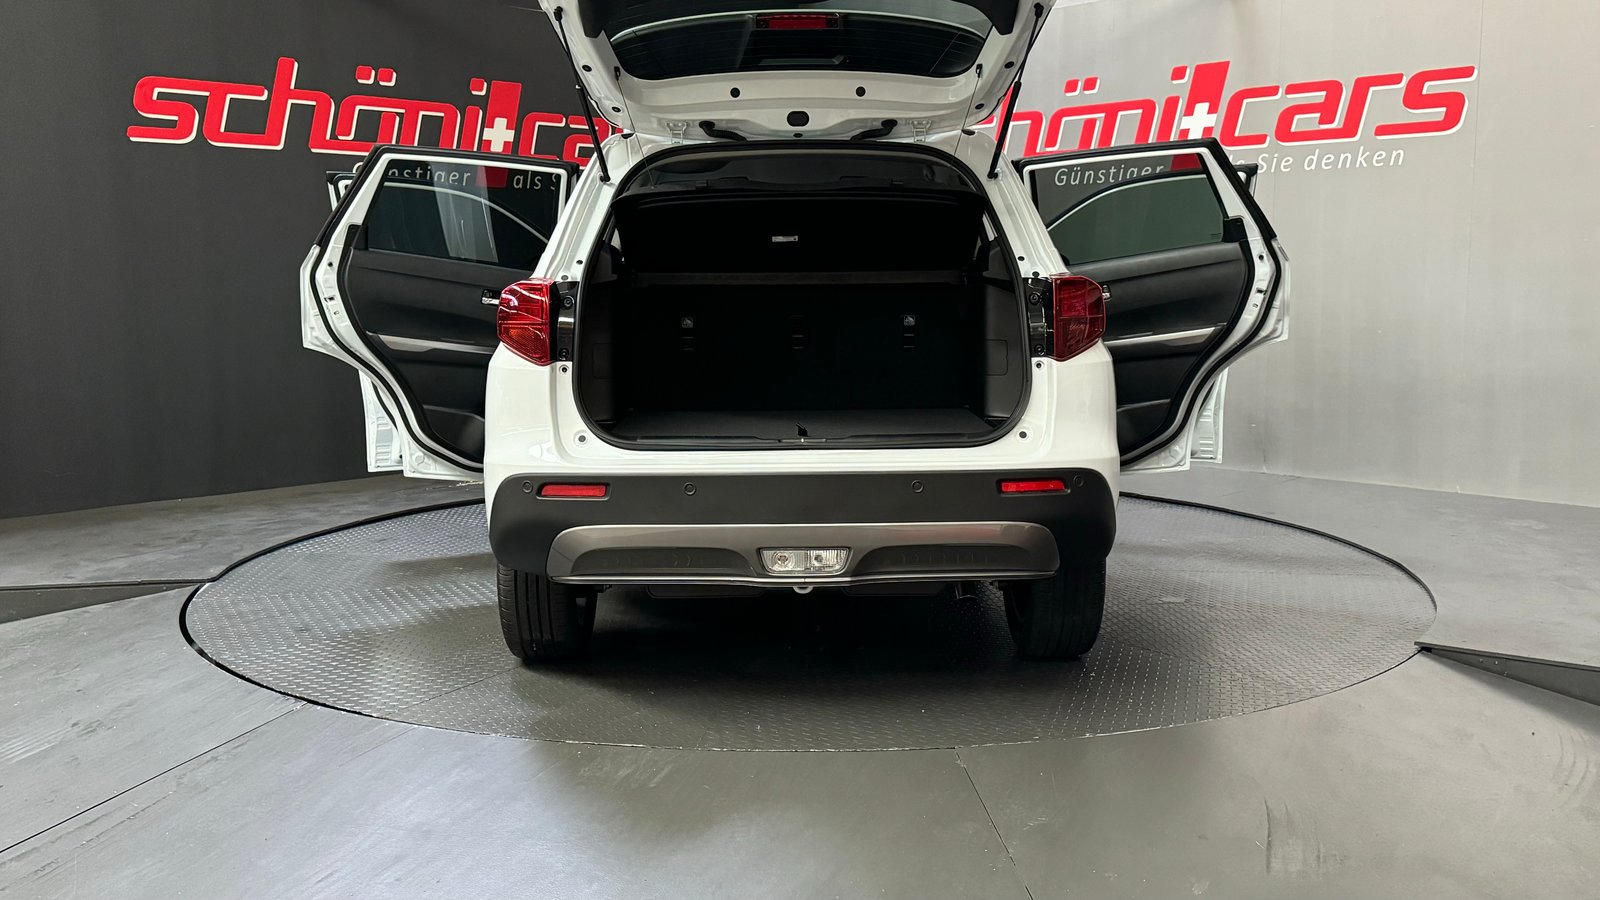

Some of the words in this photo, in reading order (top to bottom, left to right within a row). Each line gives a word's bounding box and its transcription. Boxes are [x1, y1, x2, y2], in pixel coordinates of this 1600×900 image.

[518, 112, 624, 169] ca
[1256, 153, 1293, 174] Sie
[1304, 146, 1404, 171] denken
[513, 171, 542, 190] als
